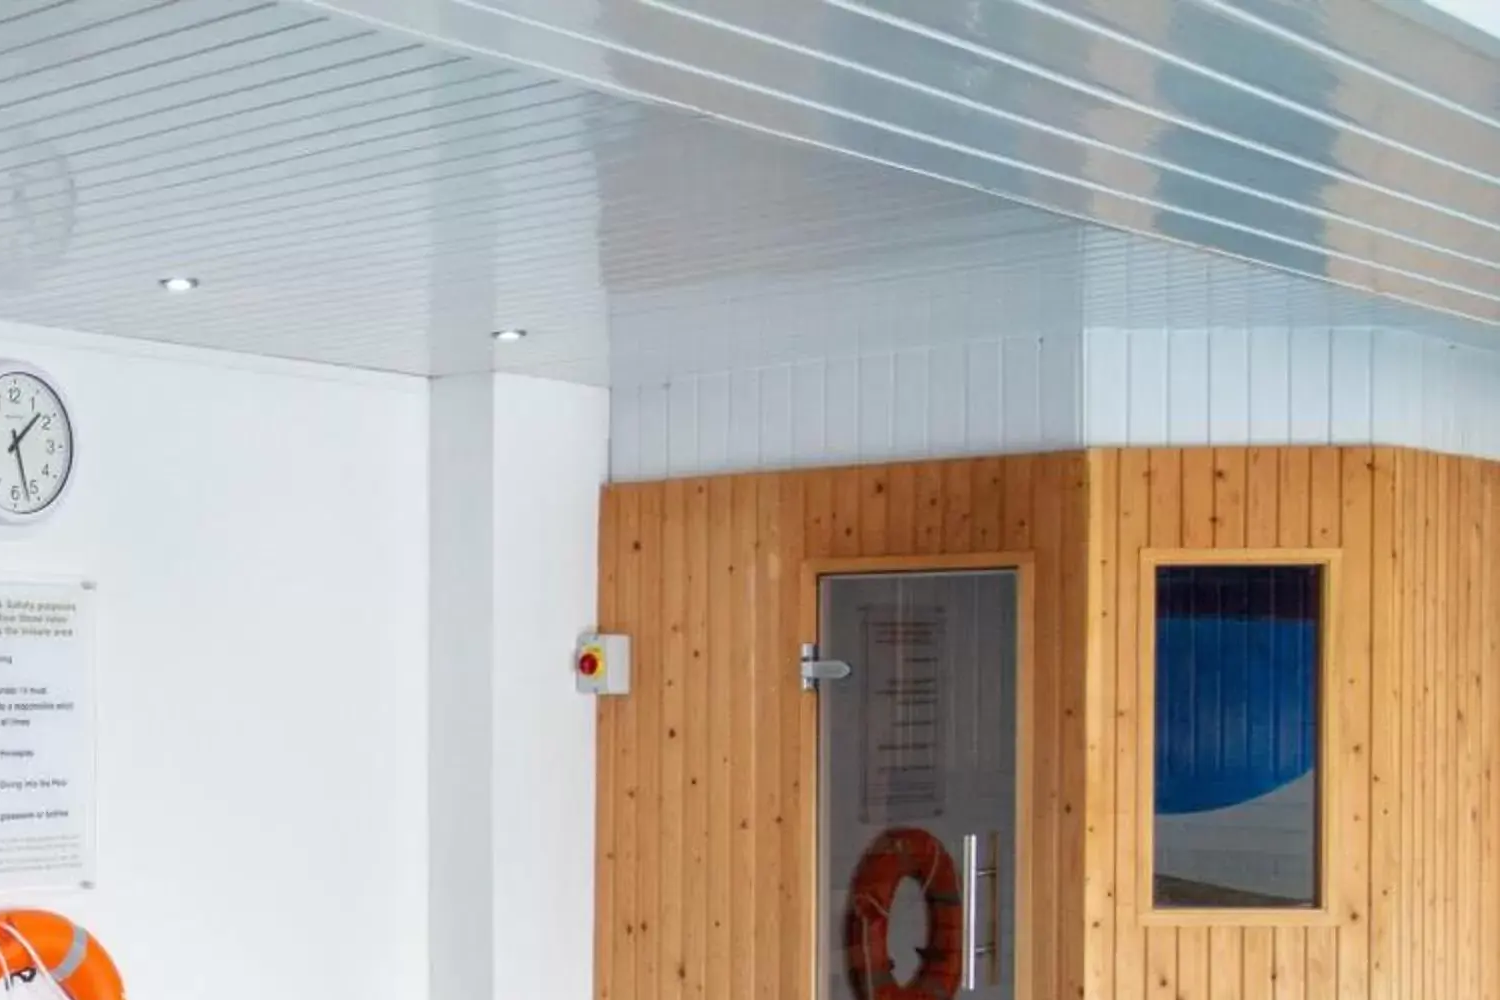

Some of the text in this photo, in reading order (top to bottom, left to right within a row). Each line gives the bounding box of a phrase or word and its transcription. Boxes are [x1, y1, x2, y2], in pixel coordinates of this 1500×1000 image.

[8, 388, 21, 404] 12
[41, 416, 52, 431] 2
[46, 439, 55, 455] 3
[41, 464, 49, 476] 4
[11, 486, 20, 500] 6
[29, 480, 39, 494] 5
